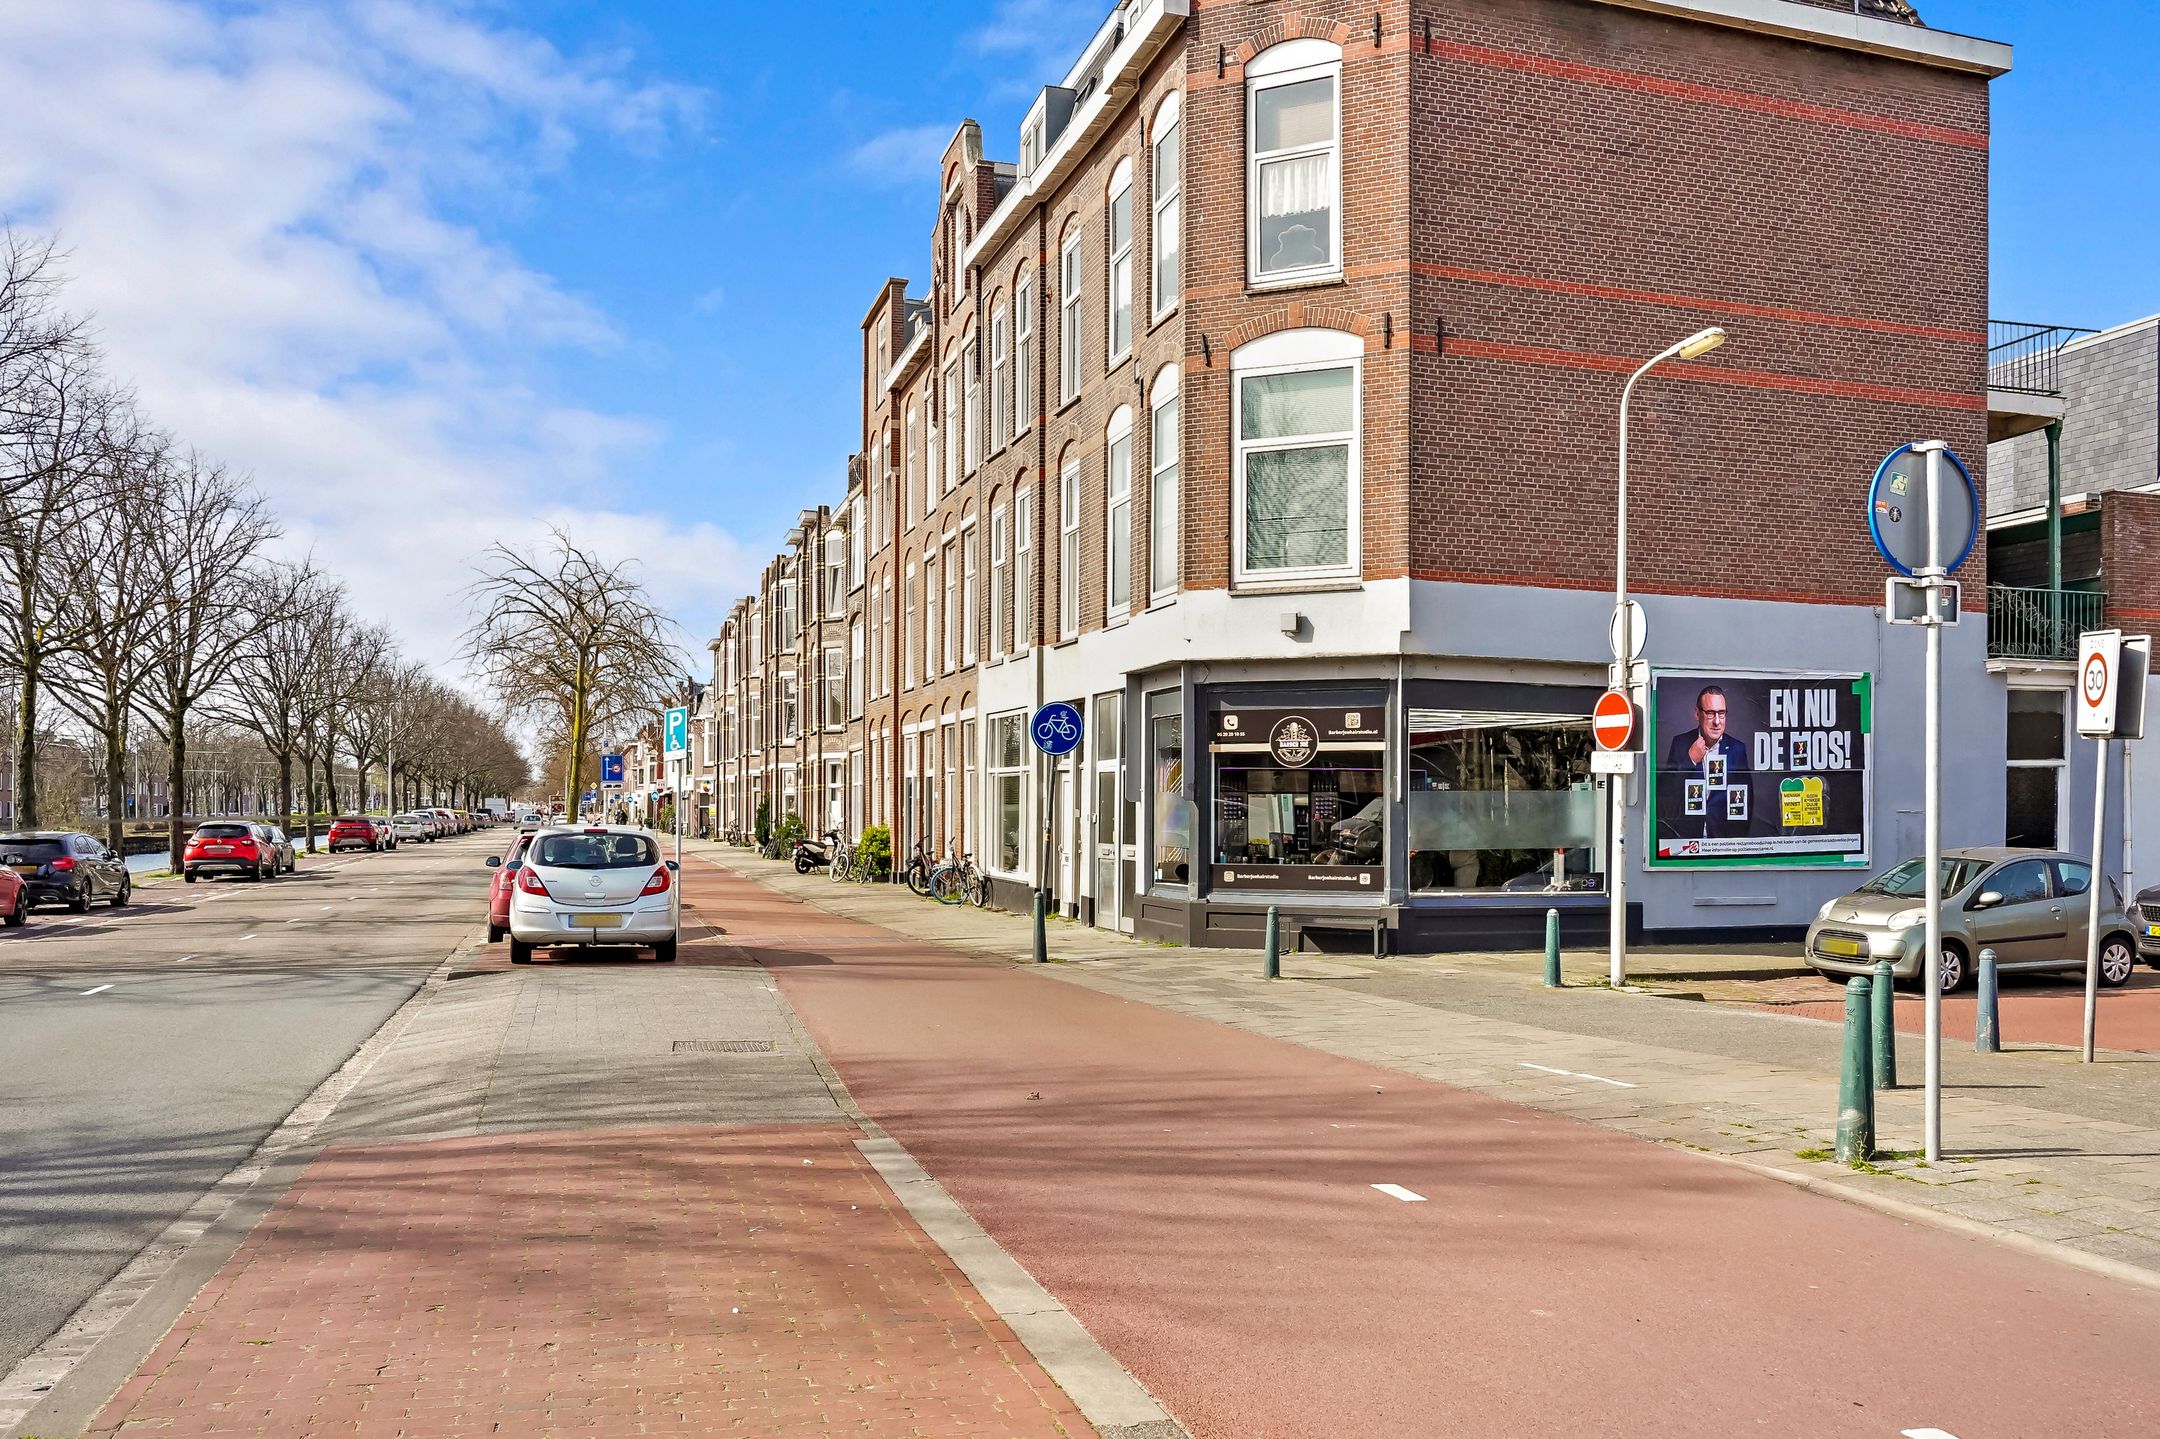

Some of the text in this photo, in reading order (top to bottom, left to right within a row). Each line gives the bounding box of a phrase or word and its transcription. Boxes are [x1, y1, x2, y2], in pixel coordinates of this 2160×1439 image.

[2087, 669, 2104, 691] 30
[669, 711, 683, 735] P
[1770, 689, 1836, 727] EN NU
[1754, 730, 1851, 771] DE OS!
